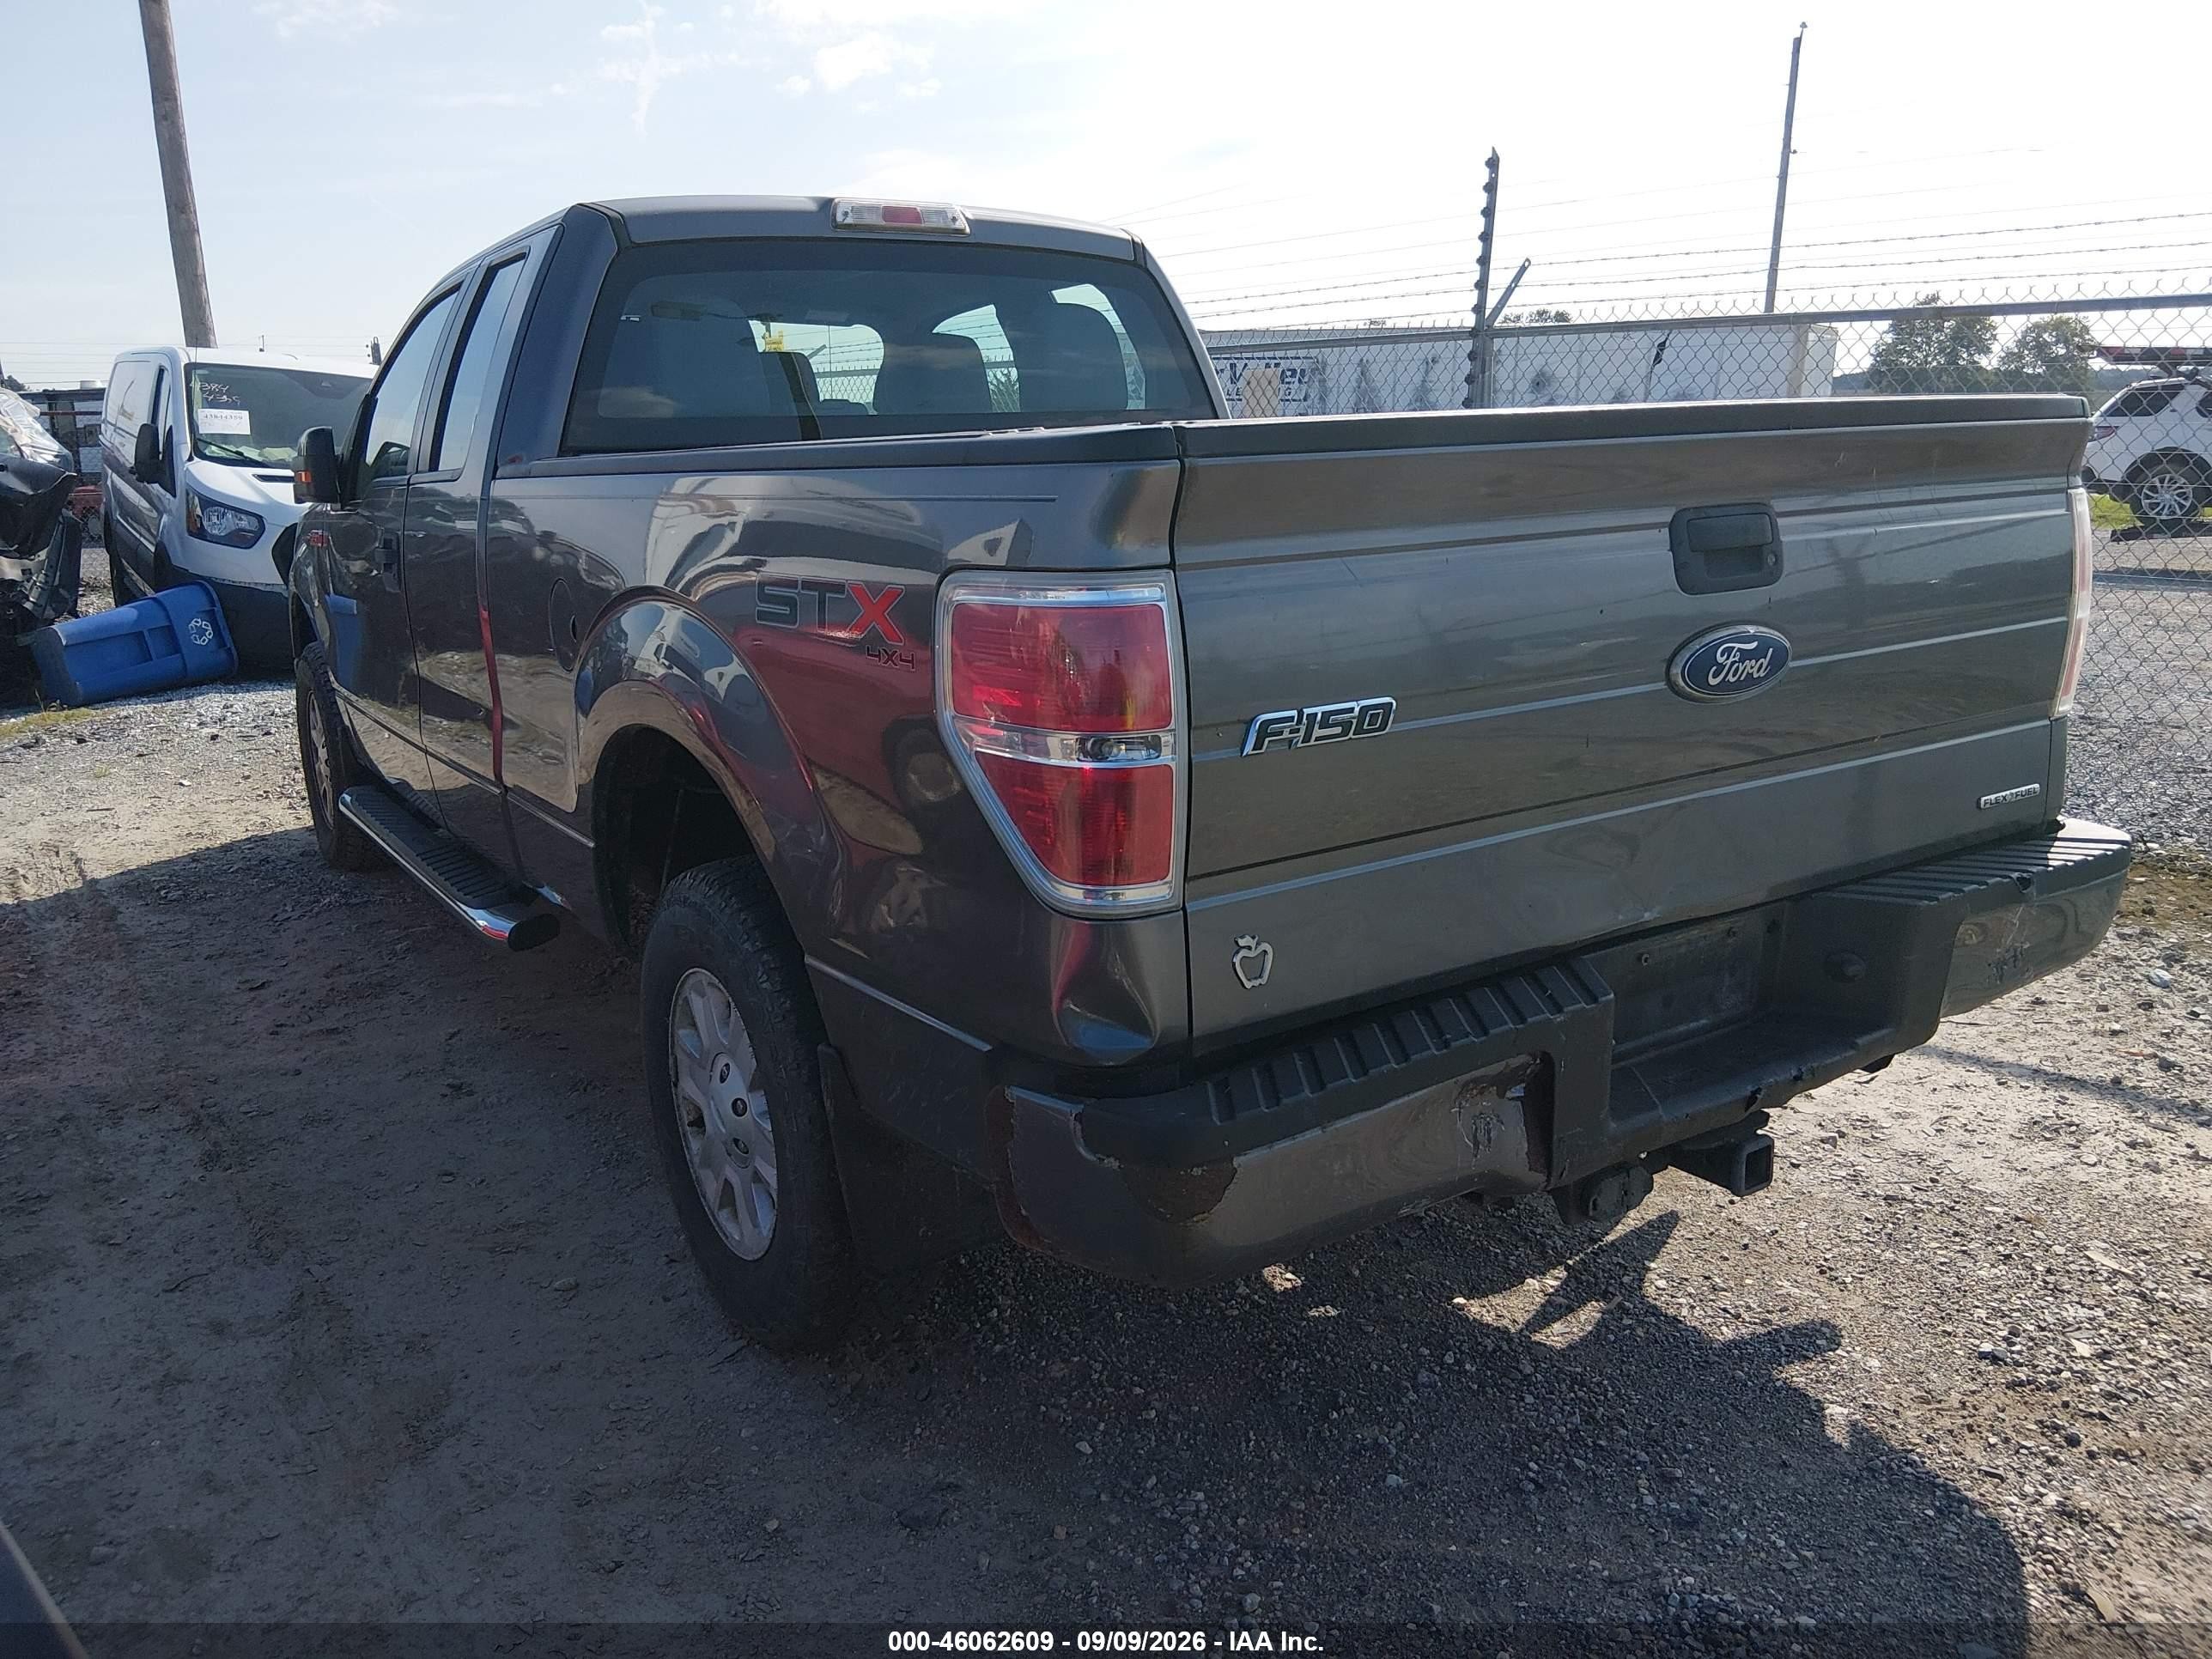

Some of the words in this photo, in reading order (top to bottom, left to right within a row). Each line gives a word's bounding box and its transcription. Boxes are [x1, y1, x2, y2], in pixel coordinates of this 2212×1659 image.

[755, 572, 906, 645] STX
[1707, 641, 1774, 687] Ford
[1243, 696, 1397, 757] F-150
[2014, 786, 2039, 799] FUEL
